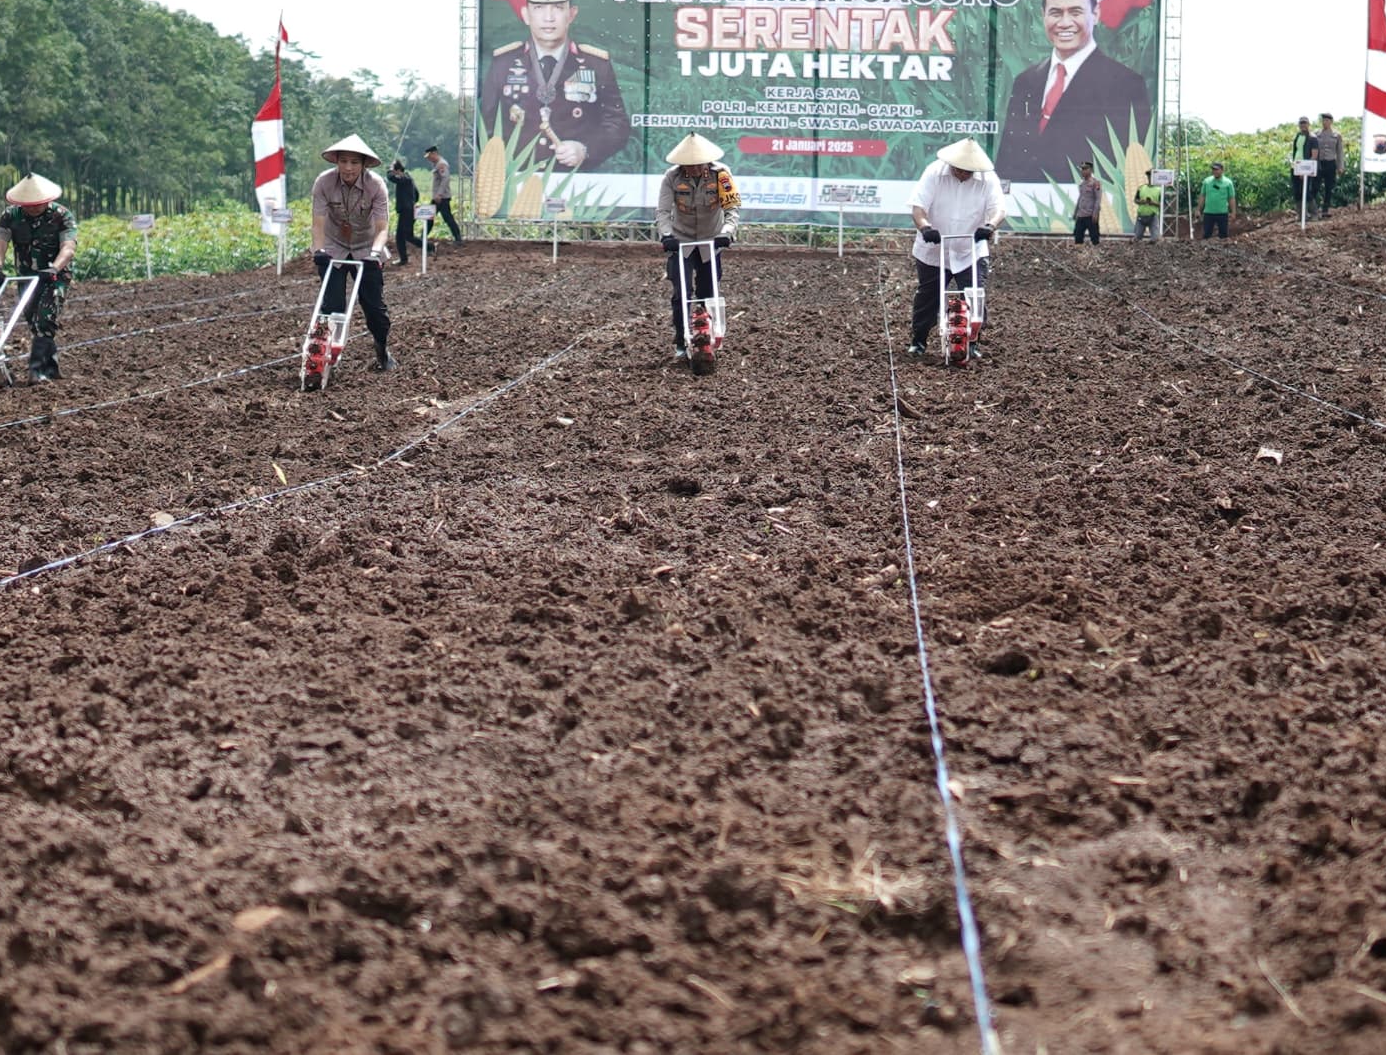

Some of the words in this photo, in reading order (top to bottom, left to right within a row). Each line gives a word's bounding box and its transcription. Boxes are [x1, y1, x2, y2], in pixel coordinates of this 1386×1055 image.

[675, 6, 957, 52] SERENTAK
[677, 51, 692, 76] 1
[698, 52, 797, 78] JUTA
[803, 53, 953, 81] HEKTAR
[766, 86, 814, 99] KERJA
[816, 87, 860, 101] SAMA
[703, 101, 746, 113] POLRI
[756, 101, 836, 115] KEMENTAN
[868, 104, 914, 116] GAPKI
[631, 114, 717, 129] PERHUTANI,
[719, 116, 788, 129] INHUTANI
[799, 117, 859, 130] SWASTA
[869, 118, 943, 132] SWADAYA
[944, 121, 998, 133] PETANI
[772, 140, 784, 151] 21
[785, 140, 826, 151] Januari
[827, 141, 854, 153] 2025
